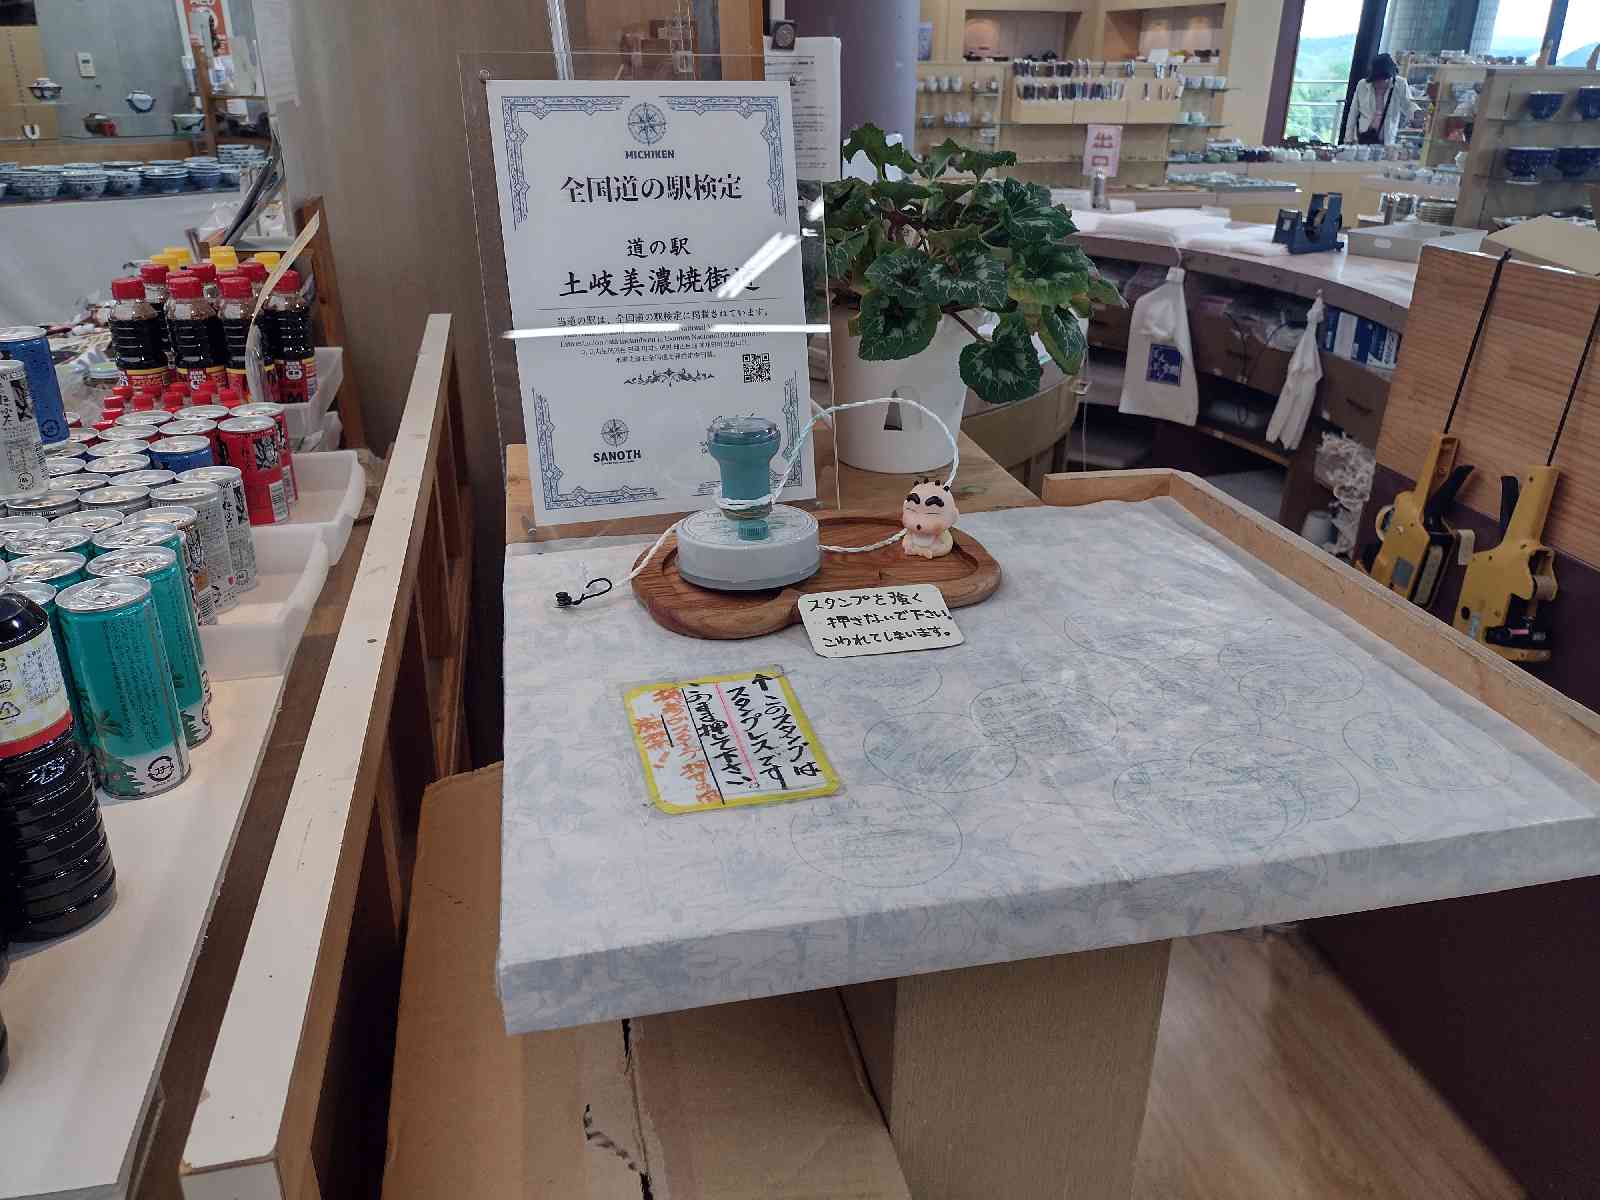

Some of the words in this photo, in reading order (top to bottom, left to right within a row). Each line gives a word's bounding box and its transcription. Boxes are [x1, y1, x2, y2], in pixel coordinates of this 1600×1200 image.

[625, 150, 676, 160] MICHIKEN
[1091, 129, 1113, 167] 出口
[560, 173, 743, 204] 全国道の駅検定
[626, 236, 692, 259] 道の駅
[559, 266, 761, 299] 土岐美濃焼街
[593, 449, 642, 463] SANOTH
[808, 591, 924, 612] スタンプを強く
[822, 625, 951, 648] こわれてしまいます。
